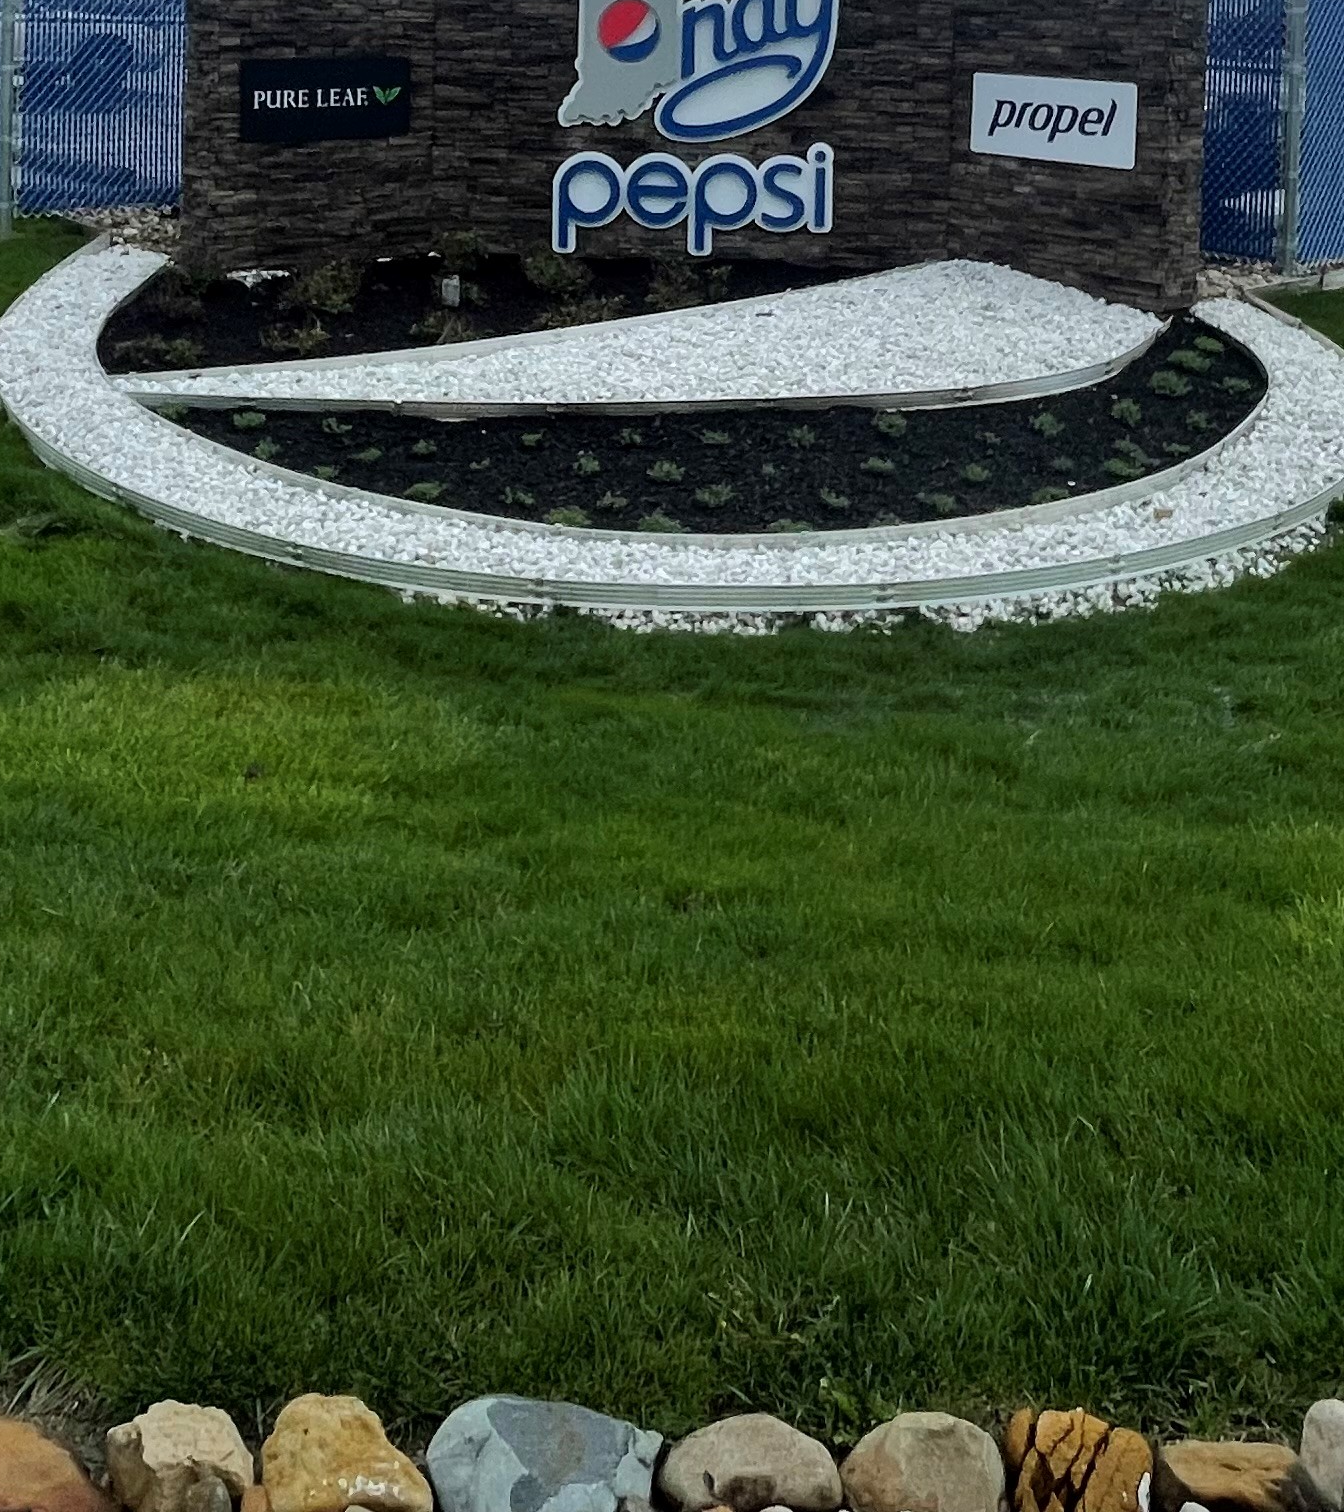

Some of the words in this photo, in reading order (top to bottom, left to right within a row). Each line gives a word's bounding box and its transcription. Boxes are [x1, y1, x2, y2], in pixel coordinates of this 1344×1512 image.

[253, 89, 309, 109] PURE
[316, 87, 369, 107] LEAF
[987, 98, 1118, 143] propel
[558, 149, 826, 252] pepsi
